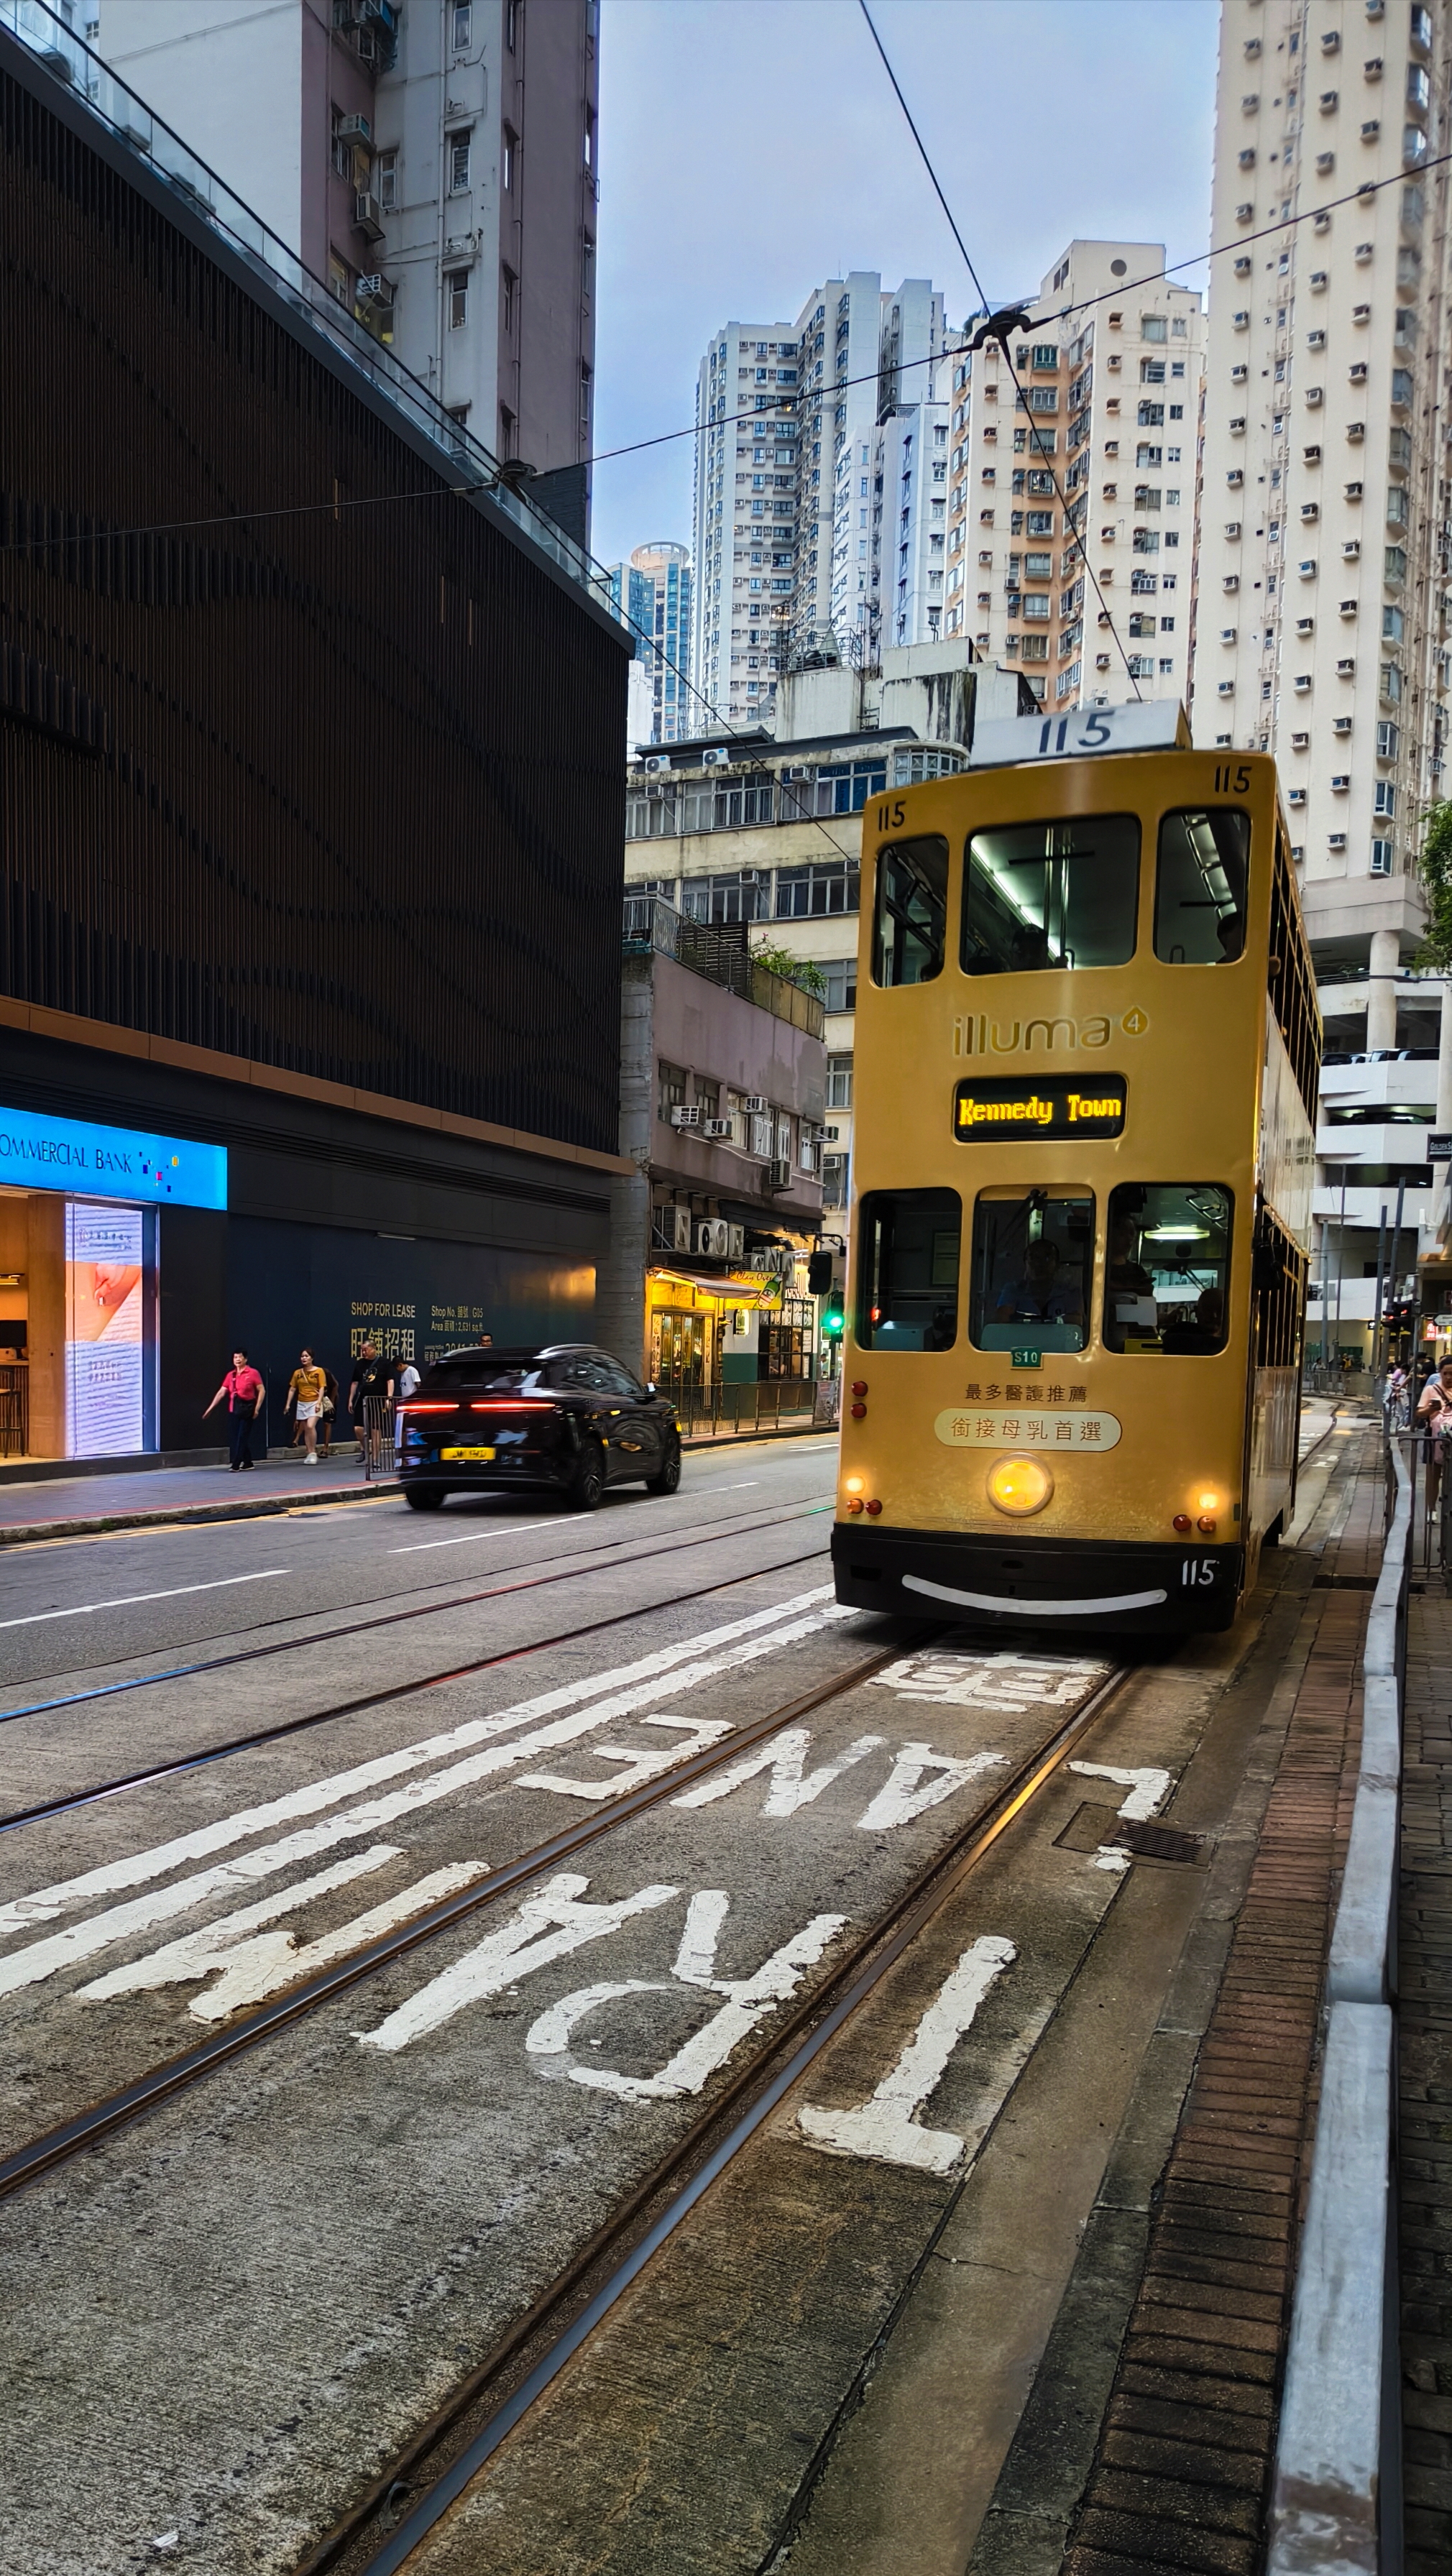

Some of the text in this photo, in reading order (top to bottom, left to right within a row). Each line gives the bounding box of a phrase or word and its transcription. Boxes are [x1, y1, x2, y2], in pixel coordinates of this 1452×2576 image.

[1038, 710, 1116, 753] 115
[1213, 765, 1252, 794] 115
[877, 801, 906, 832] 115
[953, 1013, 1111, 1057] illuma
[959, 1094, 1121, 1125] Kennedy Town
[96, 1149, 132, 1174] BANK
[351, 1302, 415, 1318] SHOP FOR LEASE
[431, 1305, 446, 1319] Shop
[447, 1306, 456, 1317] No.
[431, 1320, 443, 1331] Area
[1014, 1351, 1038, 1363] S10
[965, 1383, 1088, 1403] 最多醫護推薦
[950, 1417, 1102, 1442] 銜接母乳首選
[1182, 1558, 1217, 1586] 115
[75, 1845, 1017, 2175] TRAM
